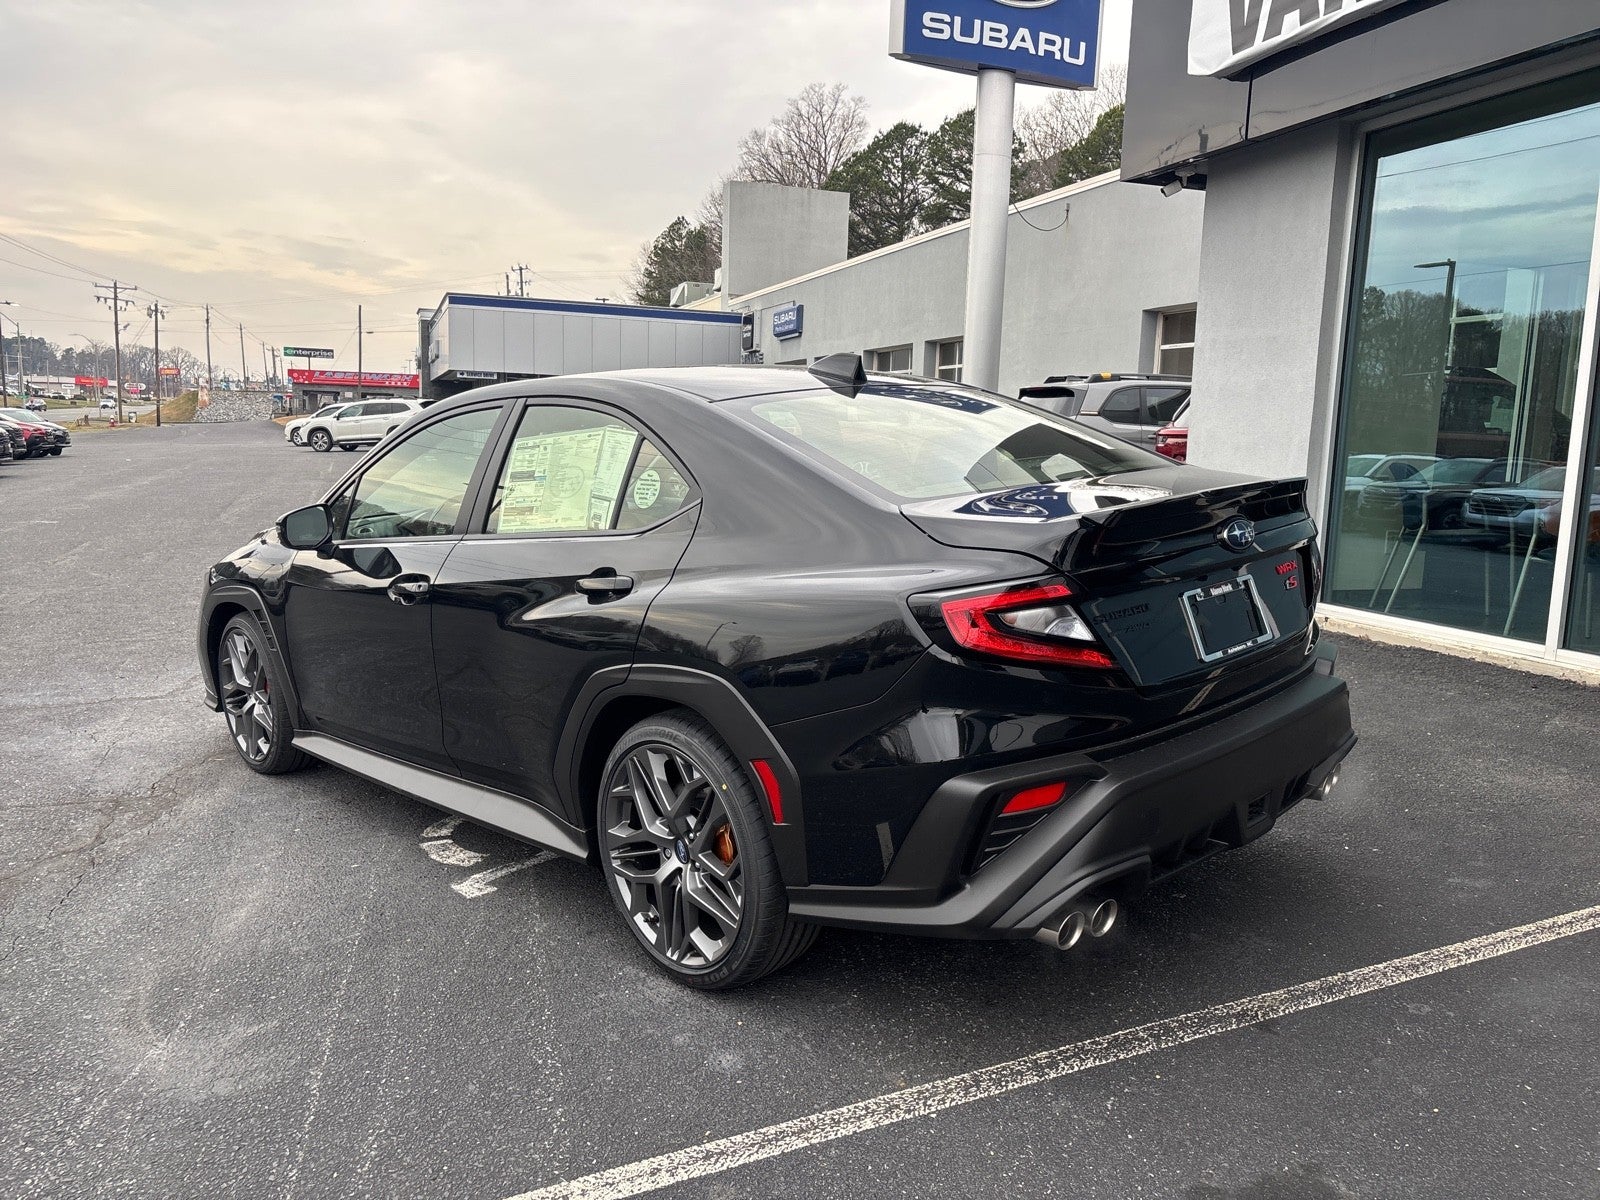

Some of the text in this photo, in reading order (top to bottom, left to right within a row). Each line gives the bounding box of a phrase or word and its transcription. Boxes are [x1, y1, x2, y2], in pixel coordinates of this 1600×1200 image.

[921, 11, 1086, 66] SUBARU
[773, 310, 797, 325] SUBARU
[284, 348, 333, 357] enterprise
[1275, 560, 1298, 575] WRX
